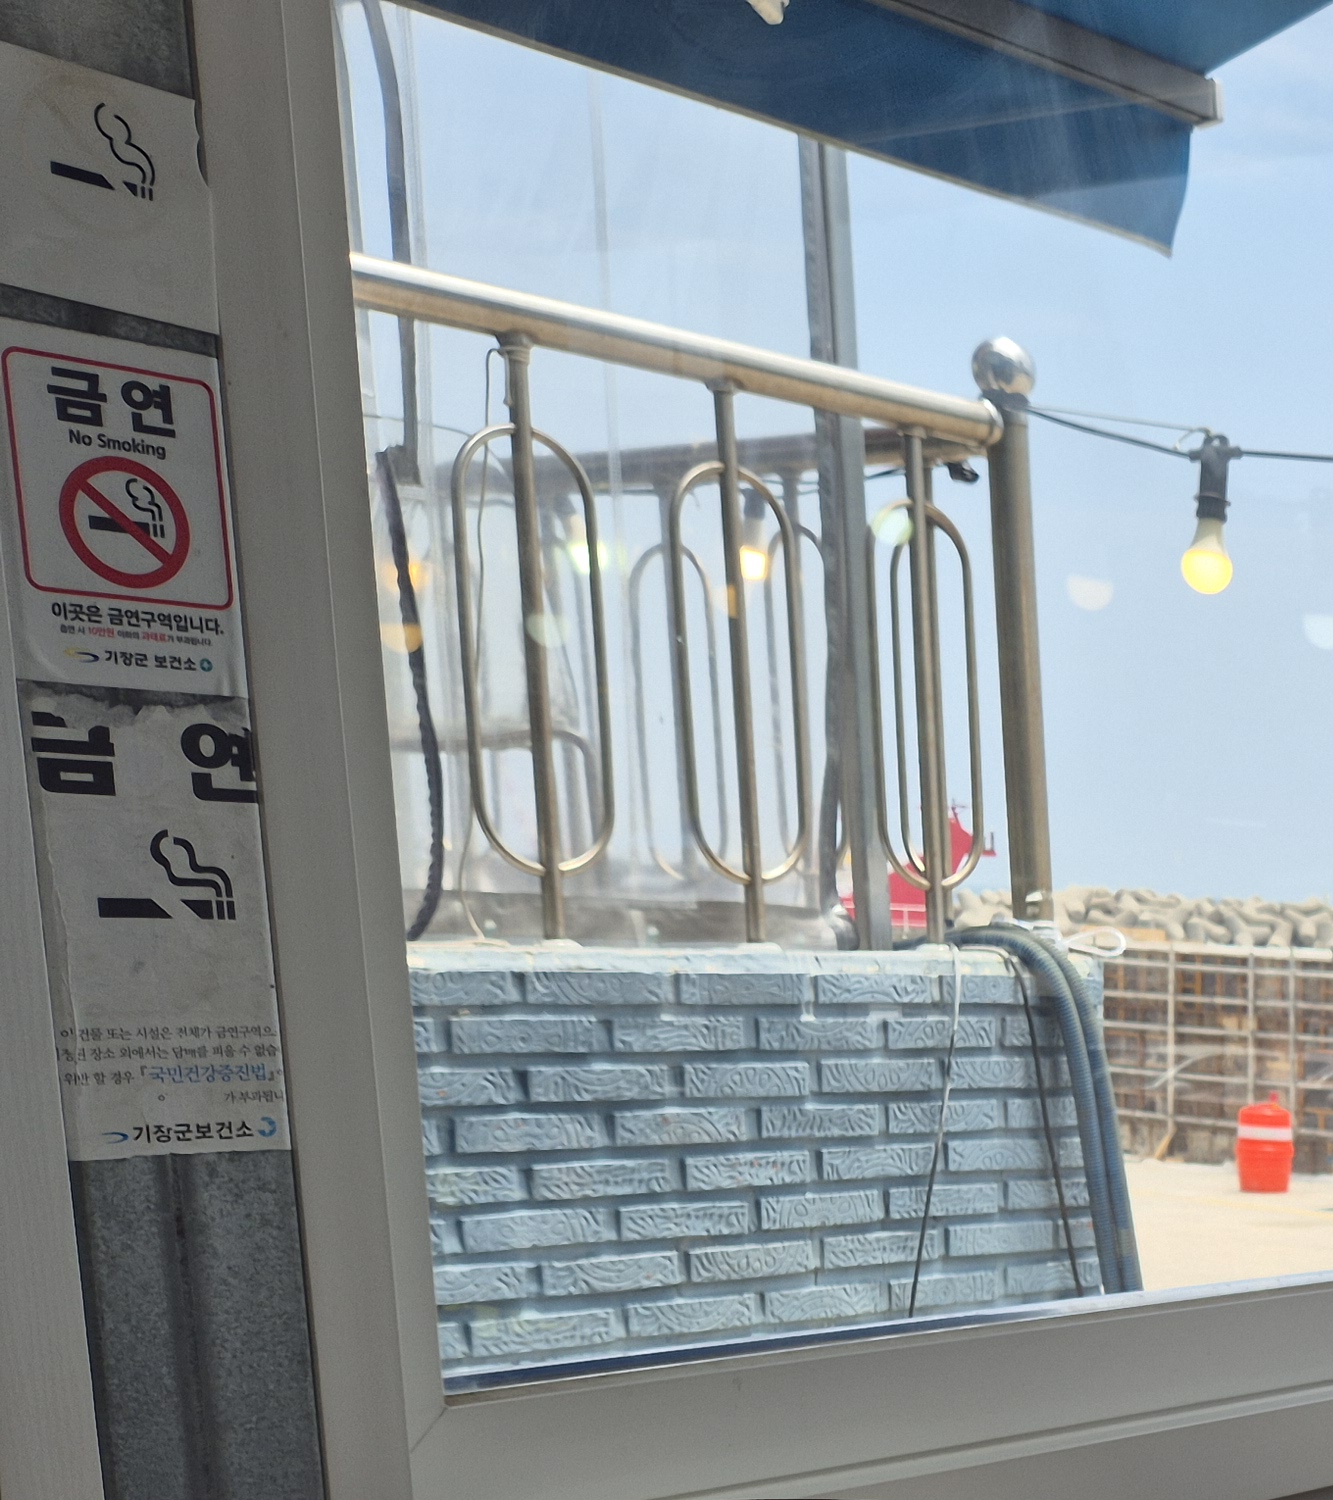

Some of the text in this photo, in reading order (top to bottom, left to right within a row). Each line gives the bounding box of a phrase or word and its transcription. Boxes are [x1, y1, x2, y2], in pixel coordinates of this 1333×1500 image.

[68, 429, 166, 460] No Smoking
[51, 602, 225, 636] 이곳은 금연구역입니다.
[104, 650, 197, 672] 기장군 보건소
[106, 1027, 133, 1041] 또는
[136, 1025, 173, 1041] 시설은
[90, 1045, 117, 1061] 장소
[119, 1044, 170, 1060] 외에서는
[172, 1045, 208, 1059] 담배를
[239, 1045, 251, 1057] 수
[110, 1070, 135, 1085] 경우
[132, 1120, 255, 1144] 기장군보건소
